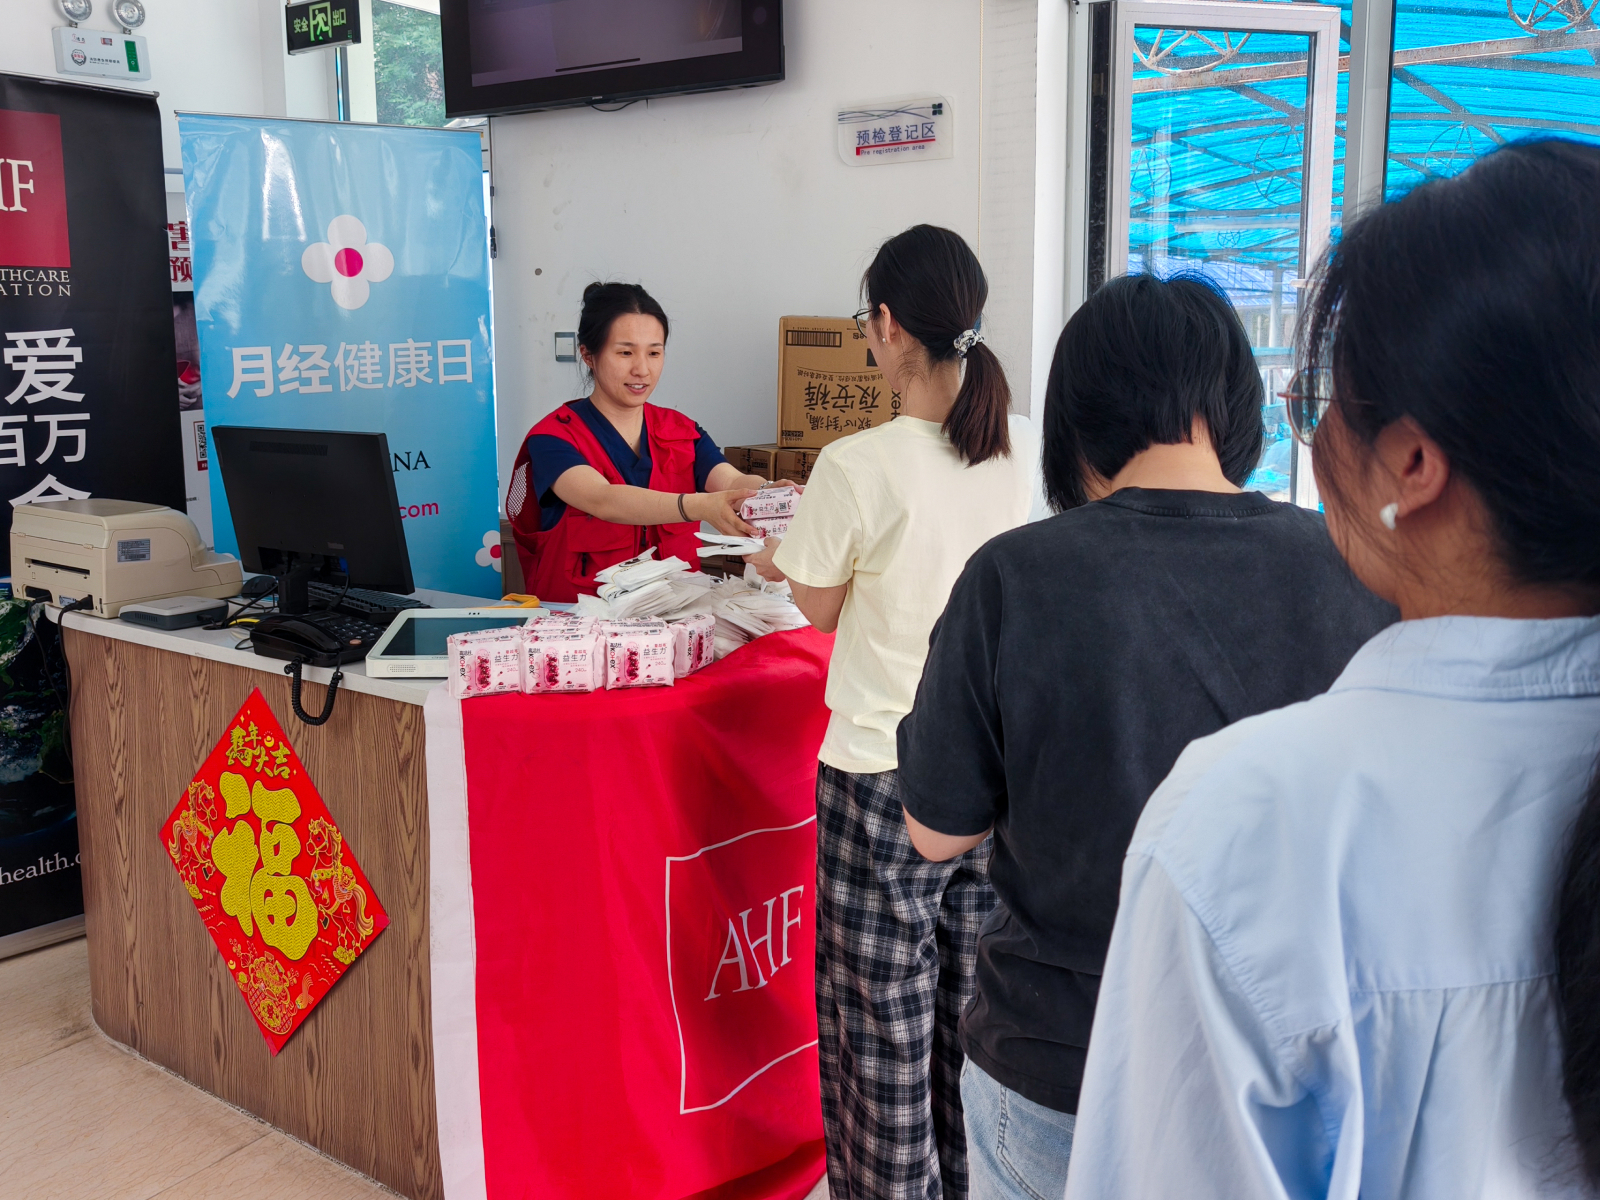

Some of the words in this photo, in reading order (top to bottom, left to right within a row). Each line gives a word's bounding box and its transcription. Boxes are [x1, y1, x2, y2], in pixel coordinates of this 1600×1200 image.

[294, 17, 308, 33] 安全
[332, 8, 347, 26] 出口
[856, 122, 935, 146] 预检登记区
[873, 146, 909, 155] registration
[3, 328, 86, 405] 爱
[226, 337, 473, 399] 月经健康日
[804, 381, 881, 413] 夜安裤
[389, 450, 431, 472] NA
[494, 654, 519, 662] 益生力
[562, 654, 588, 662] 益生力
[643, 647, 667, 655] 益生力
[211, 771, 318, 961] 福
[704, 885, 804, 1001] AHF
